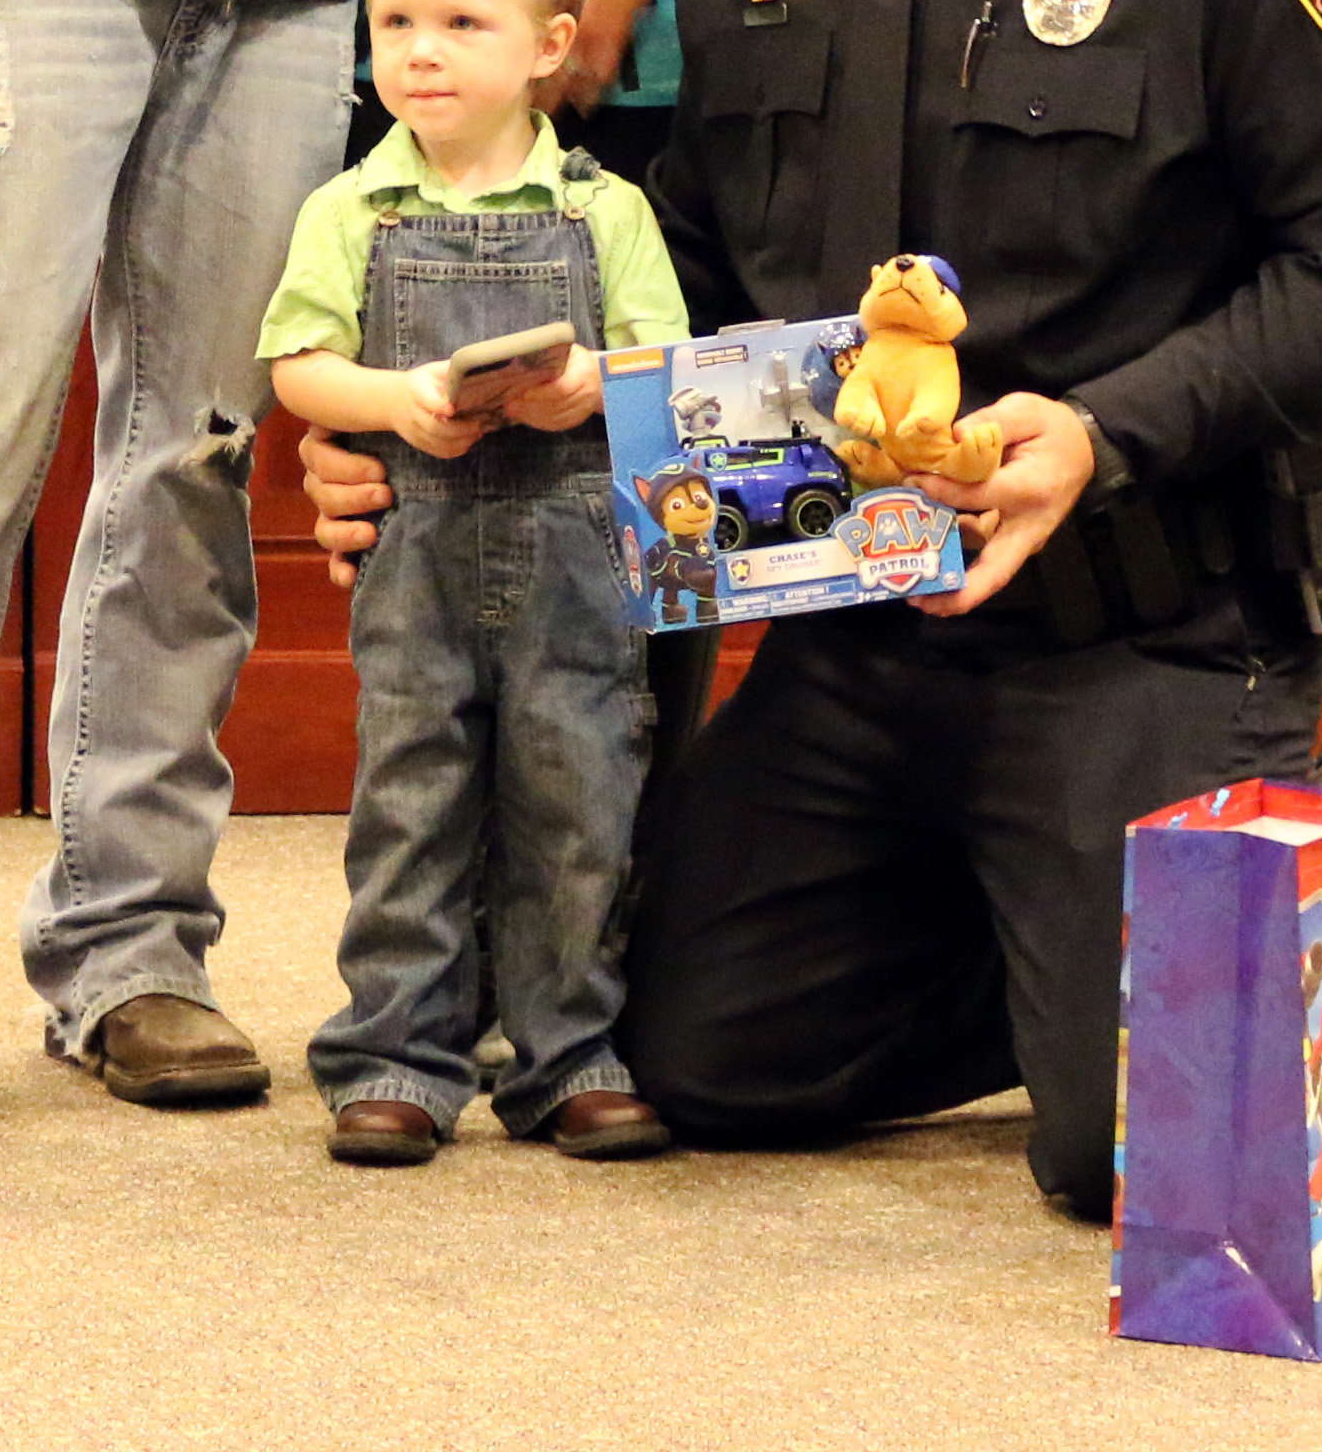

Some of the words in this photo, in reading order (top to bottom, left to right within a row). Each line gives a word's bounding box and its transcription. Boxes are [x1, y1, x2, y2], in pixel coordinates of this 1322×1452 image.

[835, 507, 953, 563] PAW
[769, 550, 817, 564] CHASE'S
[868, 557, 929, 574] PATROL
